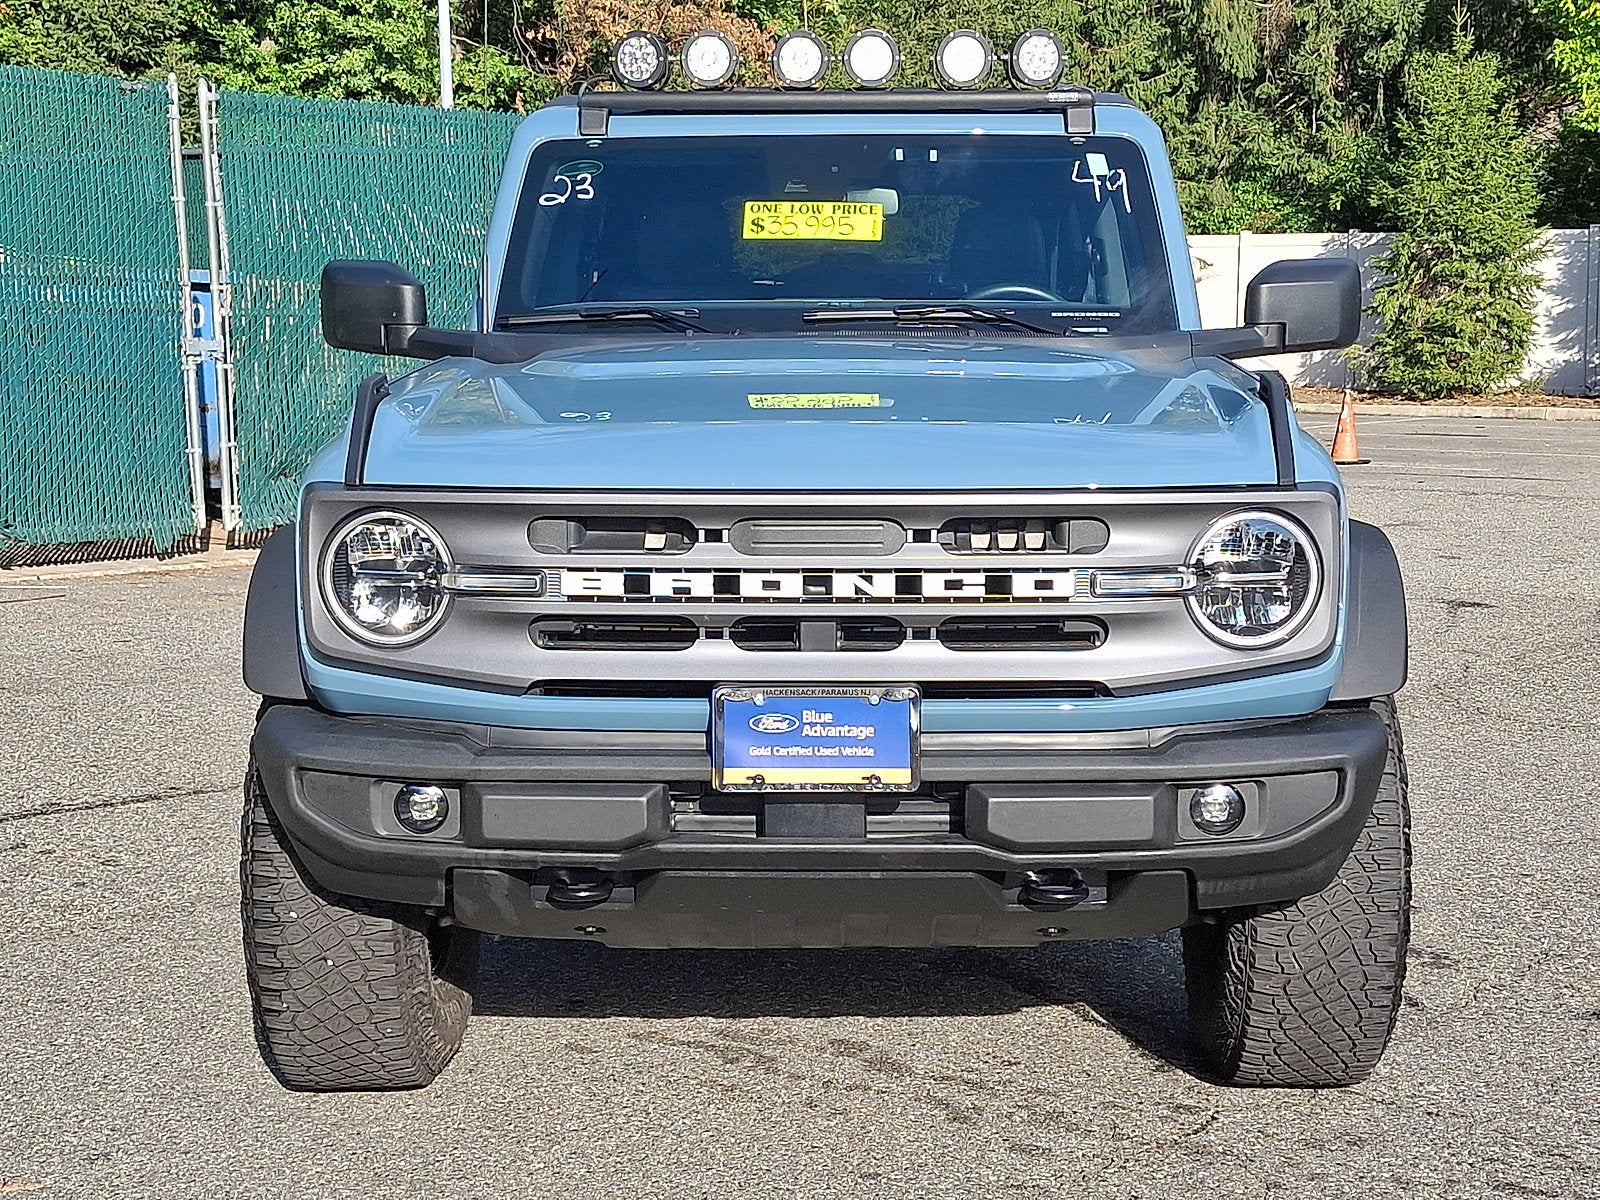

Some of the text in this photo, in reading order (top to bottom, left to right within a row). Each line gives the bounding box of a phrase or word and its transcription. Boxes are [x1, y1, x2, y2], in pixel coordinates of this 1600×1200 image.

[538, 173, 595, 206] 23
[1071, 160, 1132, 214] 49
[750, 203, 878, 215] ONE LOW PRICE
[561, 572, 1074, 598] BRONCO
[757, 716, 790, 731] Ford
[802, 710, 833, 723] Blue
[801, 724, 875, 739] Advantage
[749, 745, 875, 757] Gold Certified Used Vehicle
